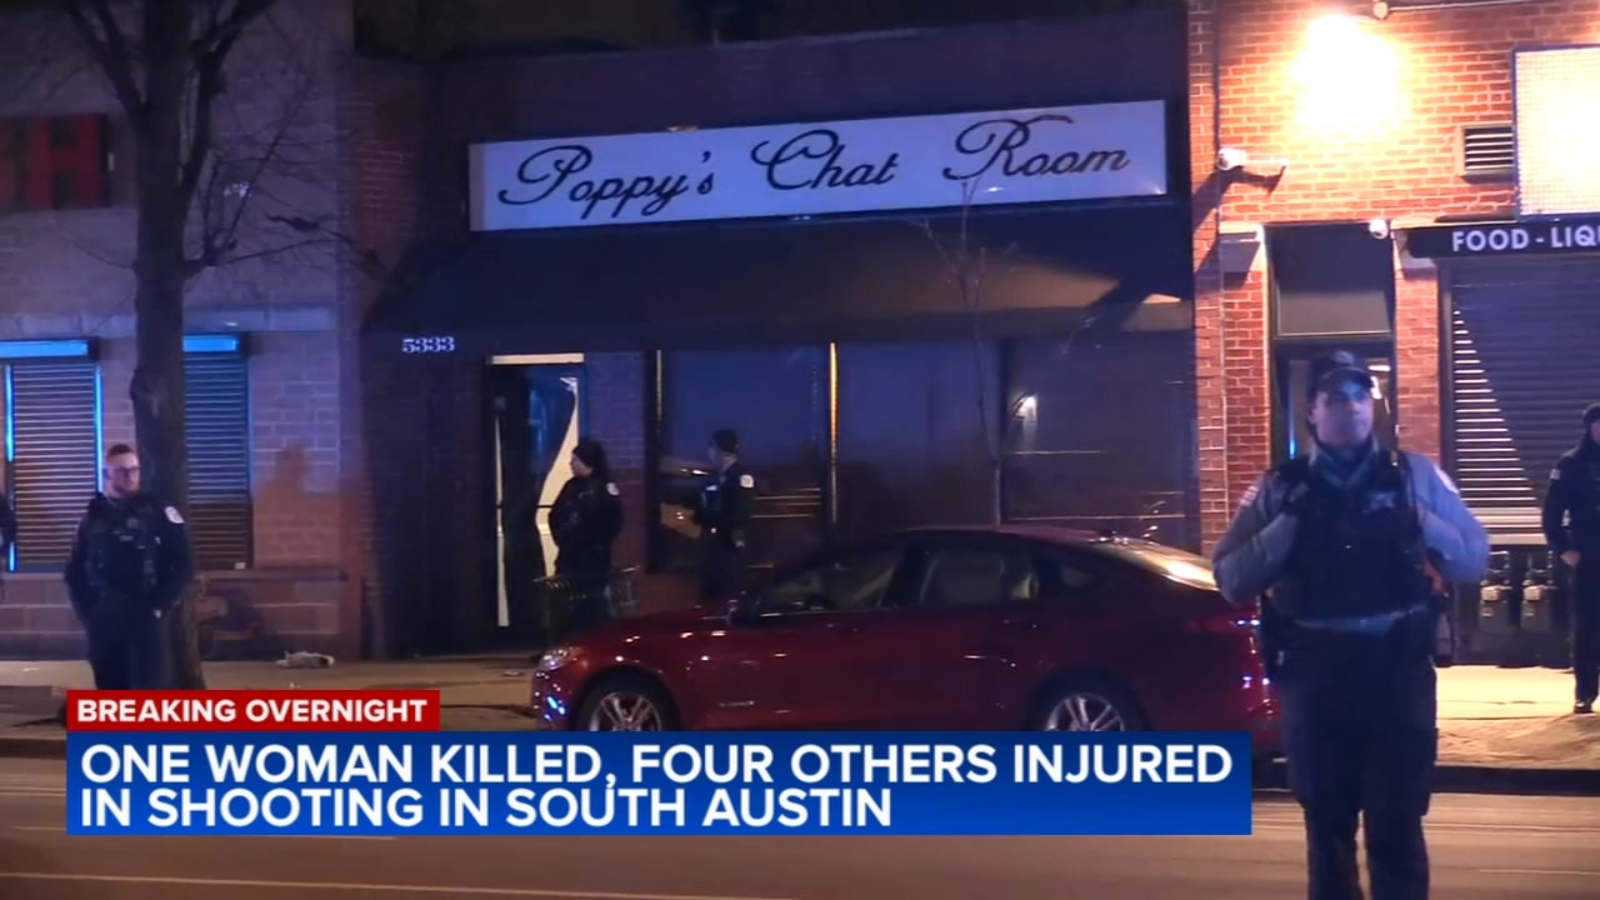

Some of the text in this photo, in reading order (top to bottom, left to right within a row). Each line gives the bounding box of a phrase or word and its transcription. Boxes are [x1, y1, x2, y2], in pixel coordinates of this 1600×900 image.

[0, 115, 98, 210] H
[497, 113, 1131, 220] Poppy's Chat Room
[1452, 228, 1530, 252] FOOD
[1550, 224, 1600, 248] LIQ
[401, 336, 455, 353] 5333
